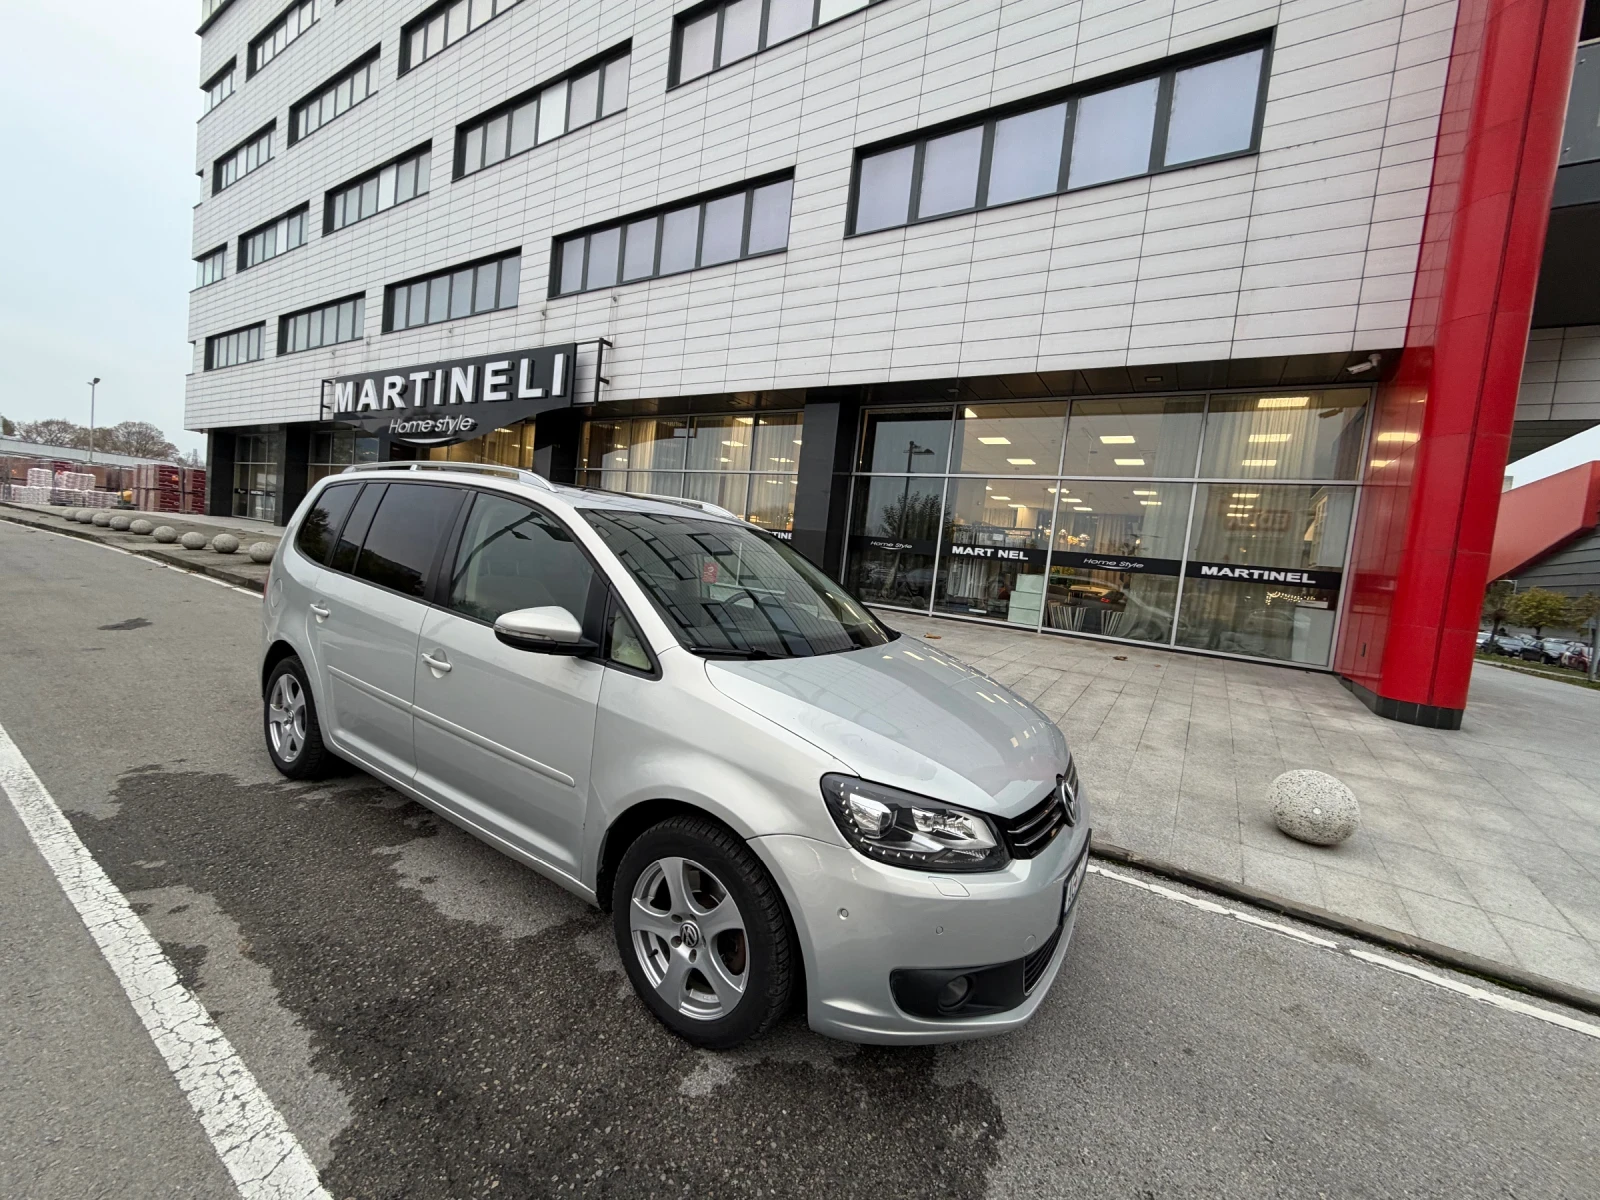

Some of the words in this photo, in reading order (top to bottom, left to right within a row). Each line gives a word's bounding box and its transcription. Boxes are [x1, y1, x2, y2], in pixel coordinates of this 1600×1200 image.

[334, 353, 566, 413] MARTINELI
[388, 417, 433, 434] Home
[434, 414, 473, 435] style
[870, 540, 894, 548] Home
[1083, 557, 1117, 566] Home
[1118, 560, 1145, 569] Style
[1201, 565, 1317, 584] MARTINEL
